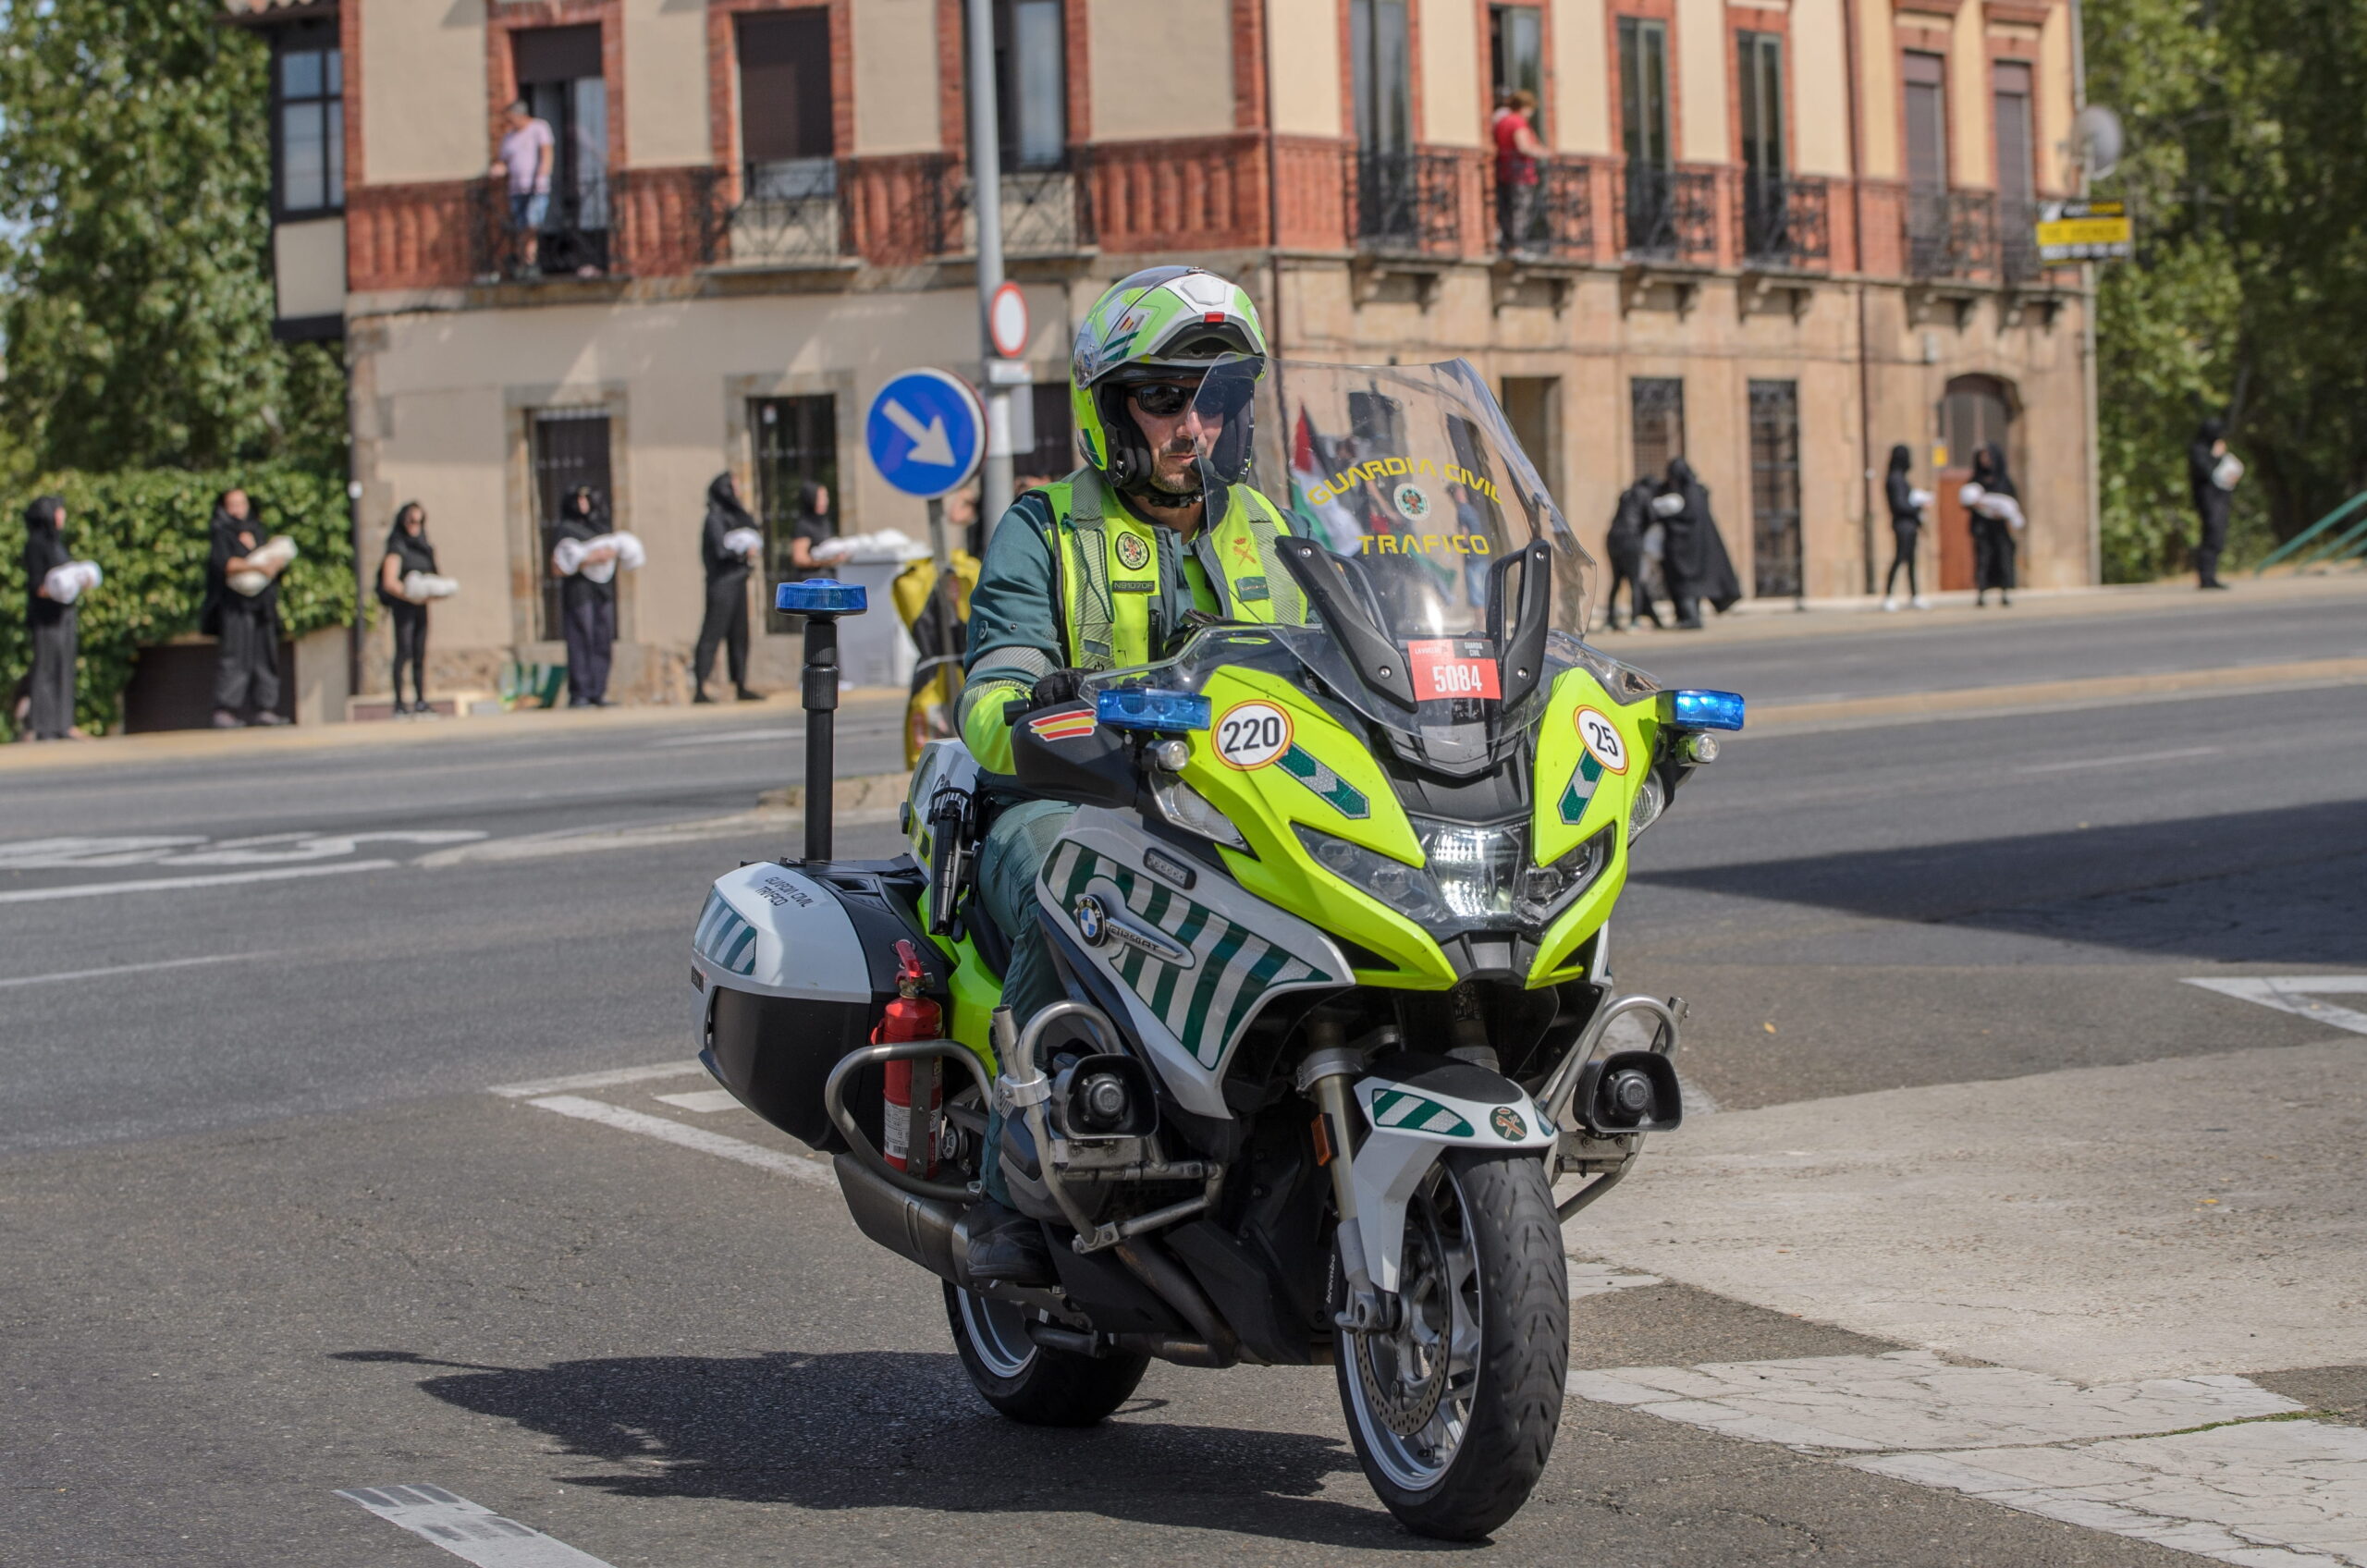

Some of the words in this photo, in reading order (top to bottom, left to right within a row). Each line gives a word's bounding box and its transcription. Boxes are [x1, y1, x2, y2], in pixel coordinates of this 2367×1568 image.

[1307, 457, 1437, 505] GUARDIA
[1444, 463, 1502, 504] CIVIL
[1356, 533, 1490, 555] TRAFICO
[1432, 665, 1483, 692] 5084
[1222, 717, 1281, 754] 220
[1588, 721, 1618, 757] 25
[791, 892, 814, 907] CIVIL
[1325, 1254, 1336, 1304] brembo
